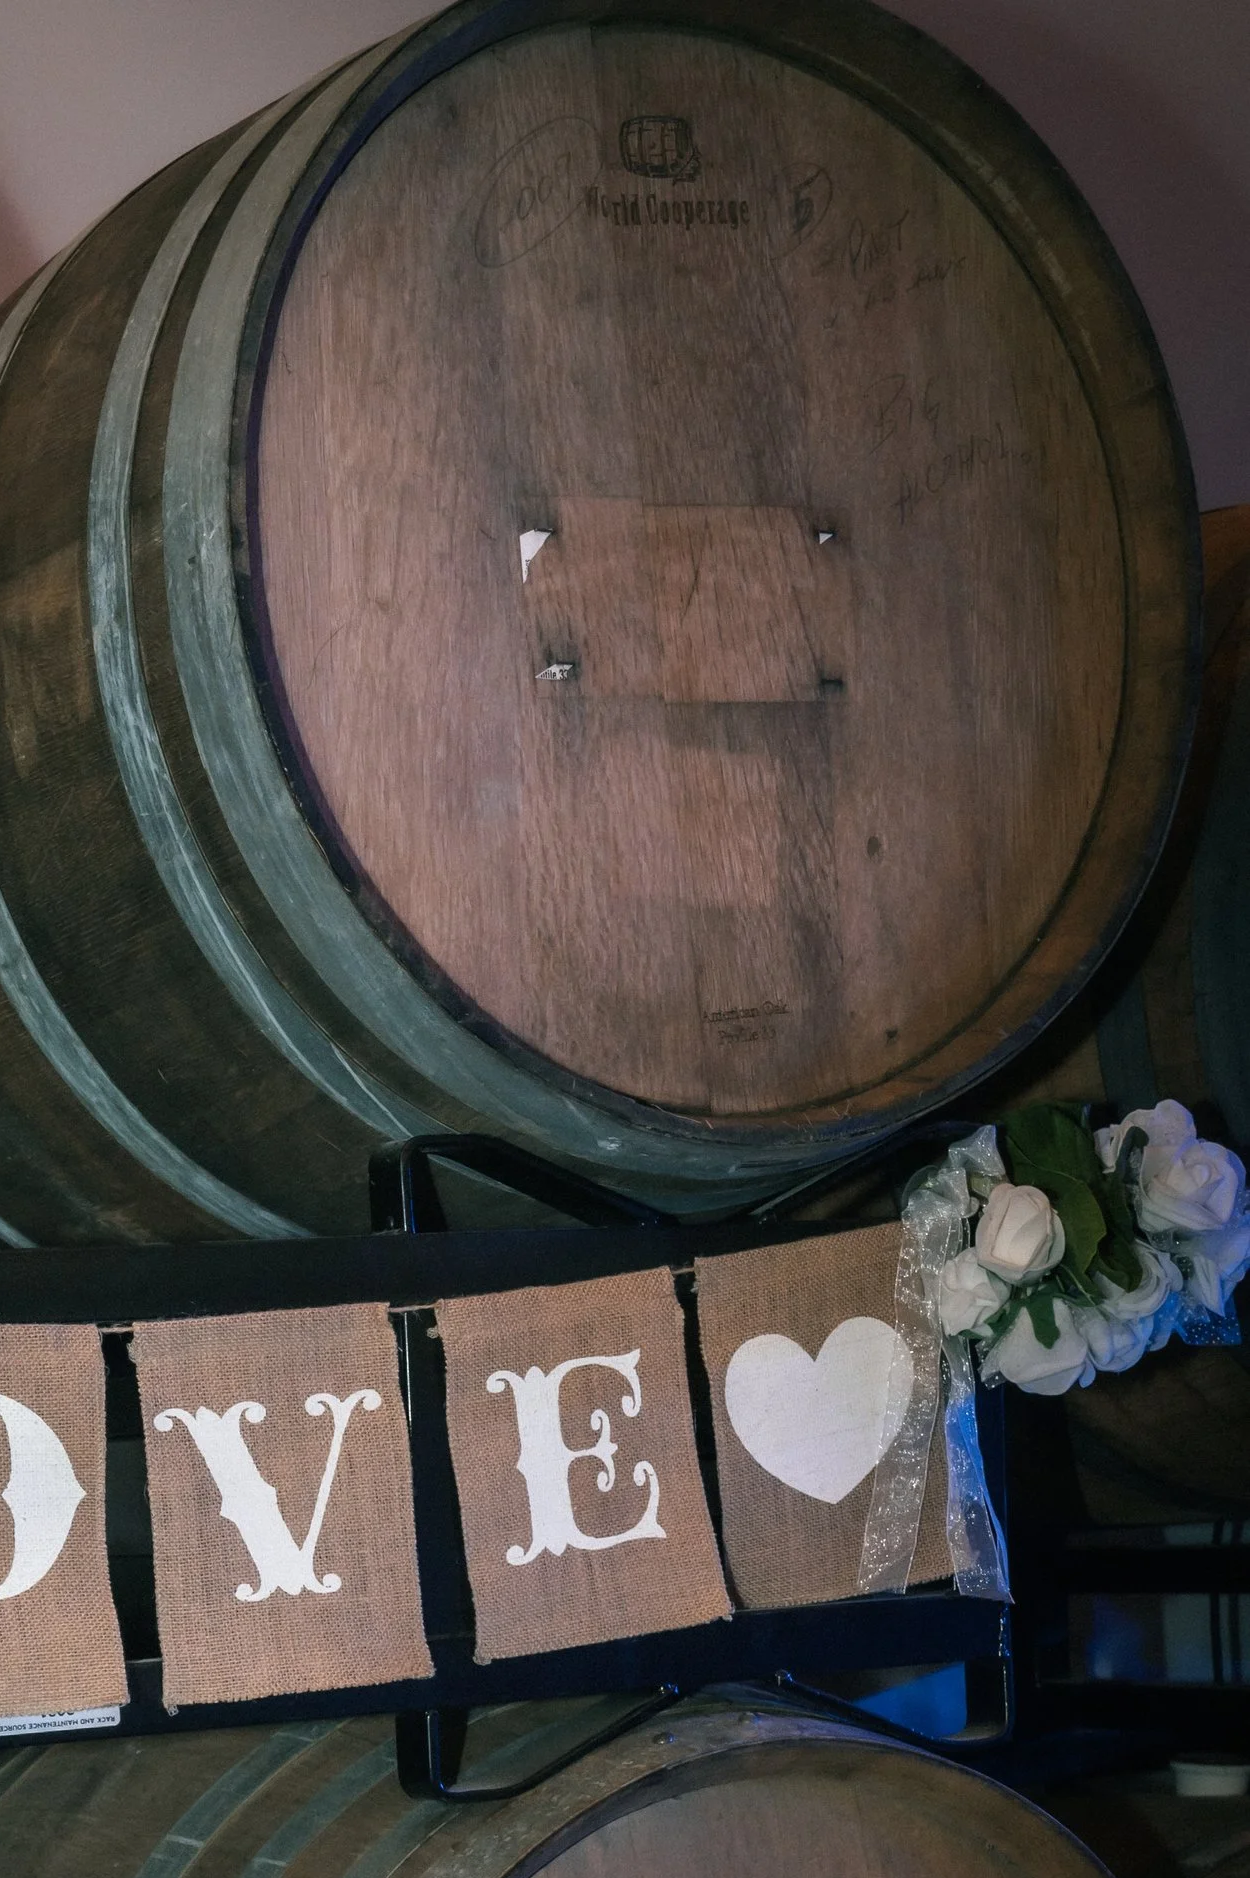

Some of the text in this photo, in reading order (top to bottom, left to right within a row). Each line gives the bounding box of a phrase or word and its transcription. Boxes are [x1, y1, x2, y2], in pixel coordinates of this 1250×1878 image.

[582, 184, 751, 231] World Cooperage
[0, 1715, 116, 1734] RACK AND MAINTENANCE SOURCE
